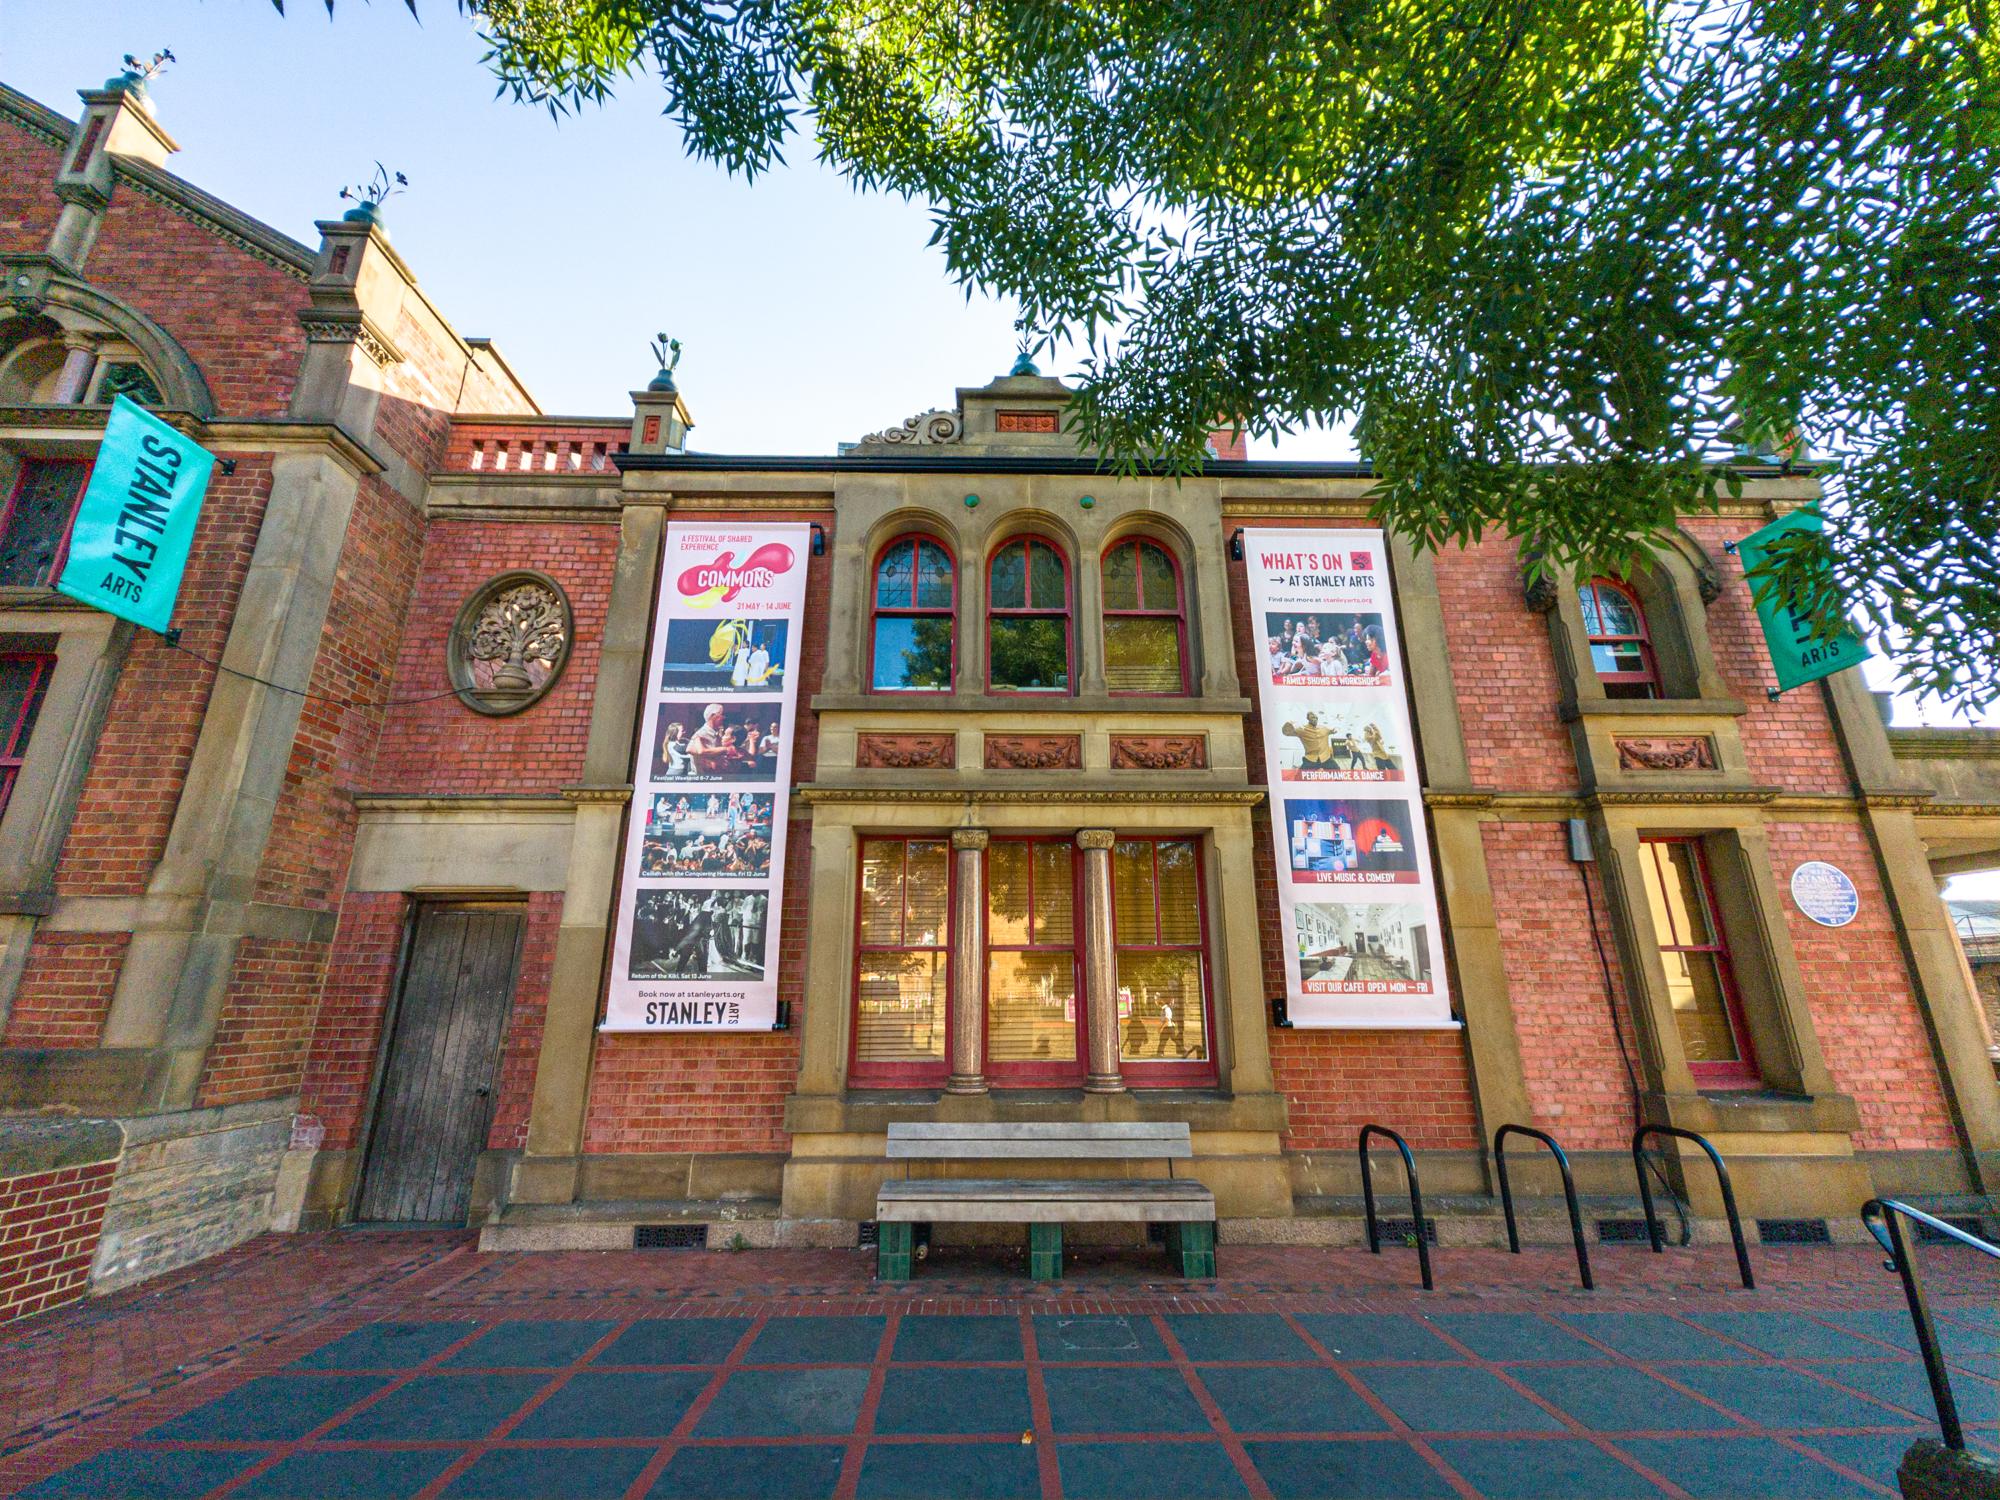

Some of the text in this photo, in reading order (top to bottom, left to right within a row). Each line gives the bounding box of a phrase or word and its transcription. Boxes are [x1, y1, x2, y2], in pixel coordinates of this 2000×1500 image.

[111, 435, 182, 581] STANLEY
[727, 535, 753, 543] SHARED
[1322, 553, 1343, 571] ON
[698, 570, 774, 587] COMMONS
[1289, 575, 1375, 587] AT STANLEY ARTS
[100, 572, 143, 603] ARTS
[746, 602, 760, 610] MAY
[775, 602, 791, 610] JUNE
[1802, 641, 1840, 667] ARTS
[1283, 677, 1380, 685] FAMILY SHOWS & WORKSHOPS
[1301, 771, 1384, 780] PERFORMANCE & DANCE
[1317, 873, 1395, 882] LIVE MUSIC & COMEDY
[1307, 983, 1326, 992] VISIT
[1328, 983, 1342, 992] OUR
[1368, 983, 1386, 992] OPEN
[1390, 983, 1406, 992] MON
[1417, 983, 1427, 992] FRI
[638, 990, 657, 998] Book
[687, 991, 745, 999] stanleyarts.org
[646, 1001, 727, 1025] STANLEY
[728, 1002, 739, 1025] ARTS
